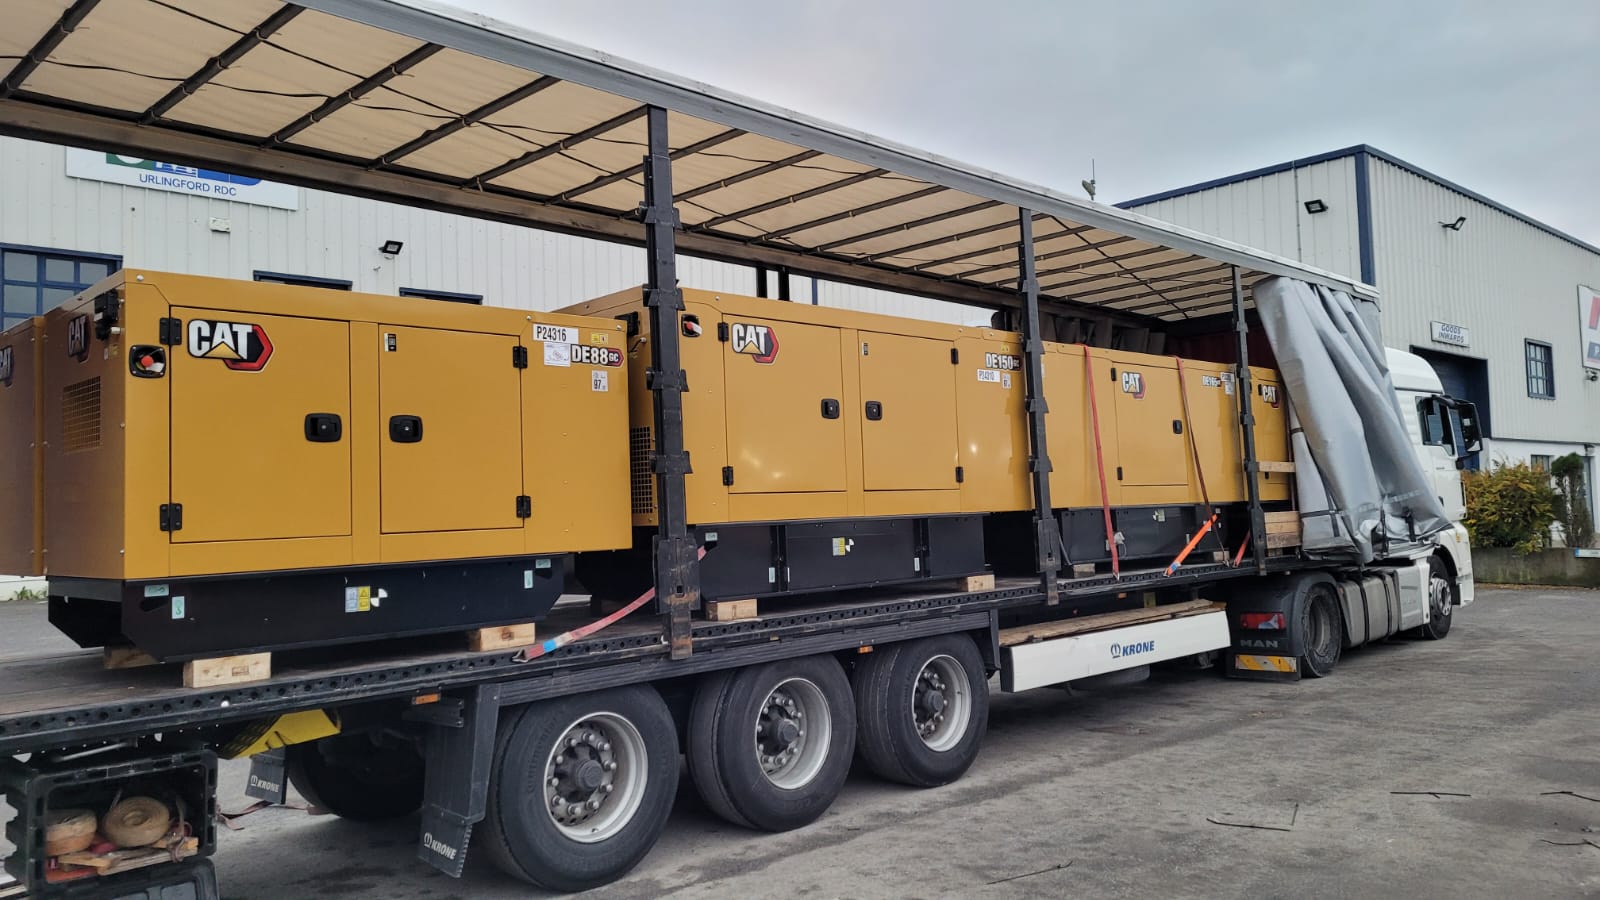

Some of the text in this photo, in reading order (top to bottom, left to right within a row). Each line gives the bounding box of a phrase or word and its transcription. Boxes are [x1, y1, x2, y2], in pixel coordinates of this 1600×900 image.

[139, 173, 237, 197] URLINGFORD RDC
[68, 316, 87, 357] CAT
[536, 326, 567, 341] P24316
[732, 323, 768, 355] CAT
[1441, 324, 1461, 335] GOODS
[188, 319, 253, 360] CAT
[571, 344, 609, 365] DE88
[985, 353, 1013, 370] DE150
[1122, 372, 1140, 393] CAT
[1262, 385, 1277, 403] CAT
[1122, 641, 1155, 656] KRONE
[1240, 640, 1279, 648] MAN
[257, 779, 280, 793] KRONE
[431, 839, 457, 860] KRONE
